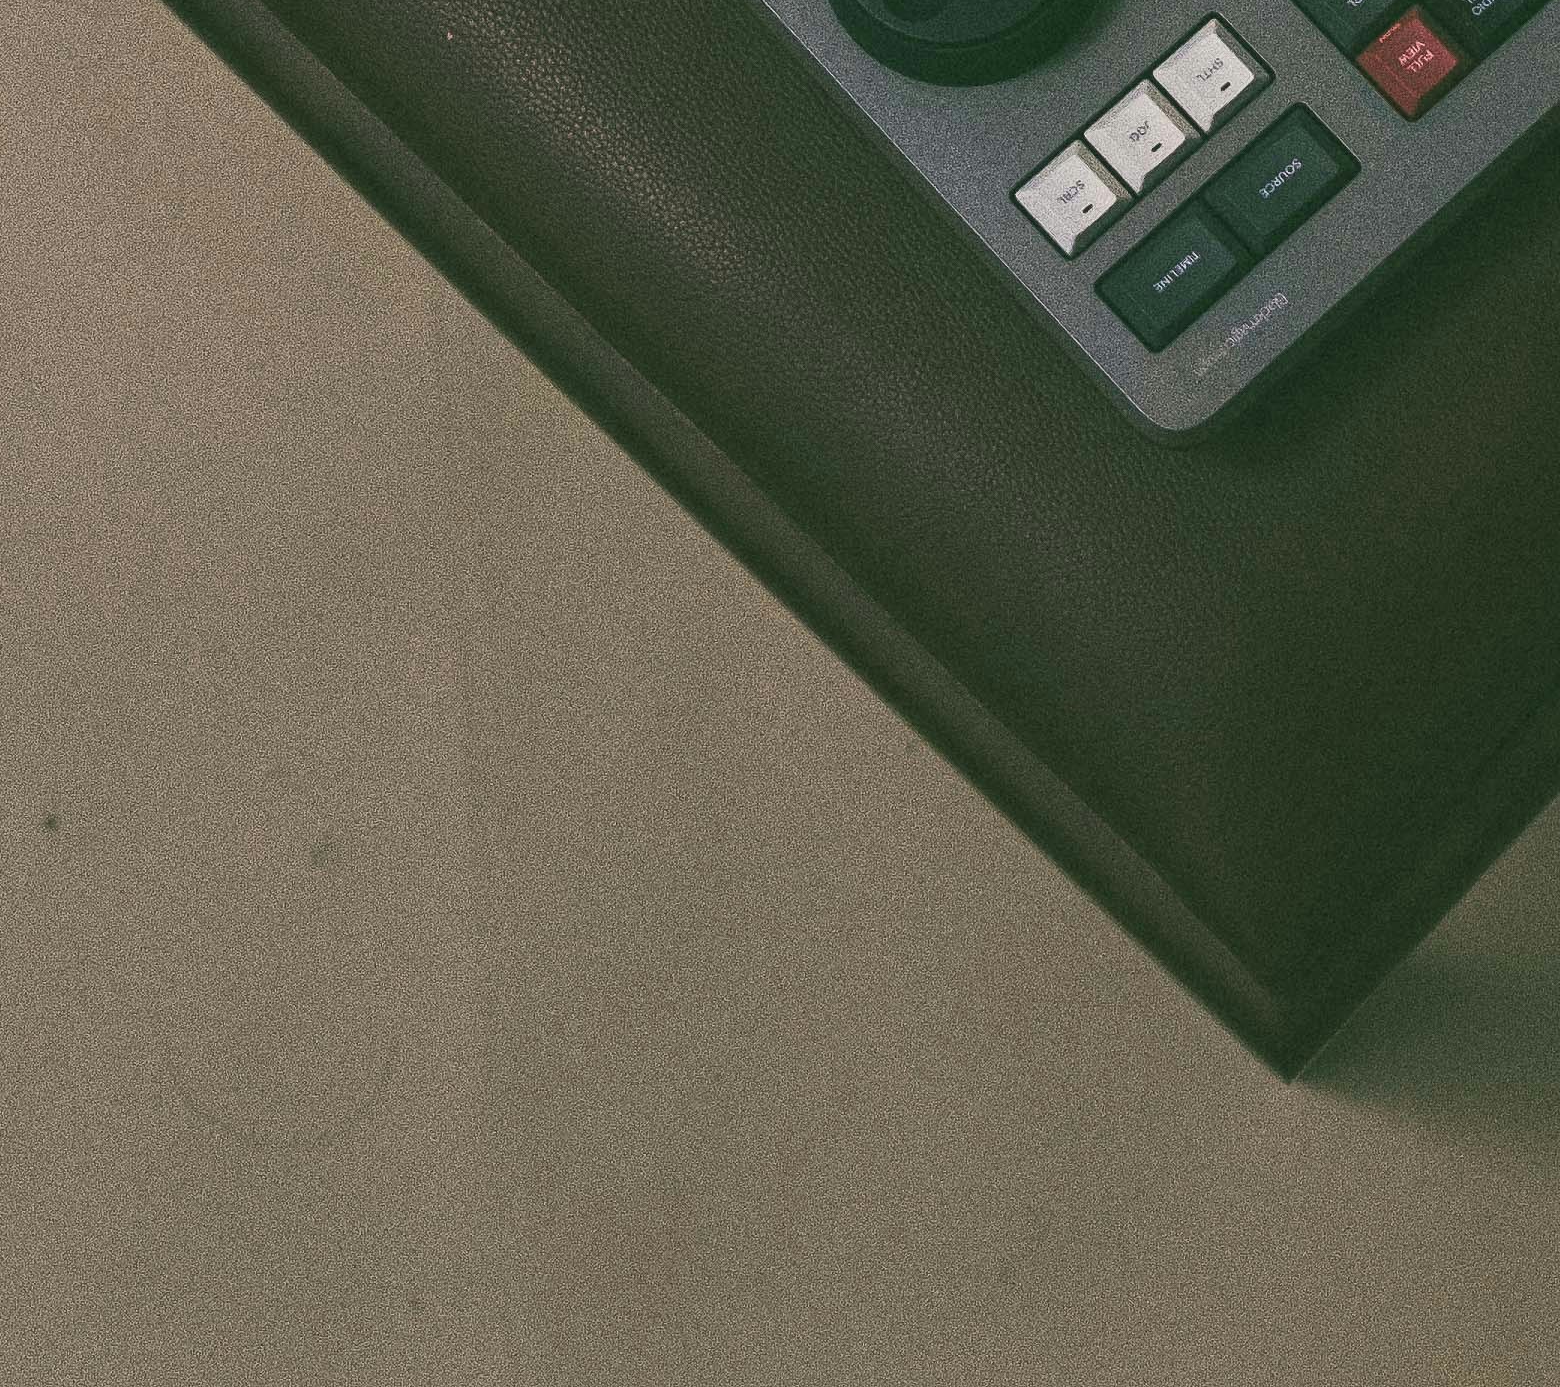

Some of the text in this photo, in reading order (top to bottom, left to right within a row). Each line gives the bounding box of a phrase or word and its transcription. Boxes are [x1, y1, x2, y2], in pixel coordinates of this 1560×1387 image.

[1394, 37, 1425, 67] VIEW
[1405, 48, 1434, 75] FULL
[1126, 119, 1152, 144] JOG
[1257, 156, 1303, 200] SOURCE
[1151, 248, 1200, 295] TIMELINE
